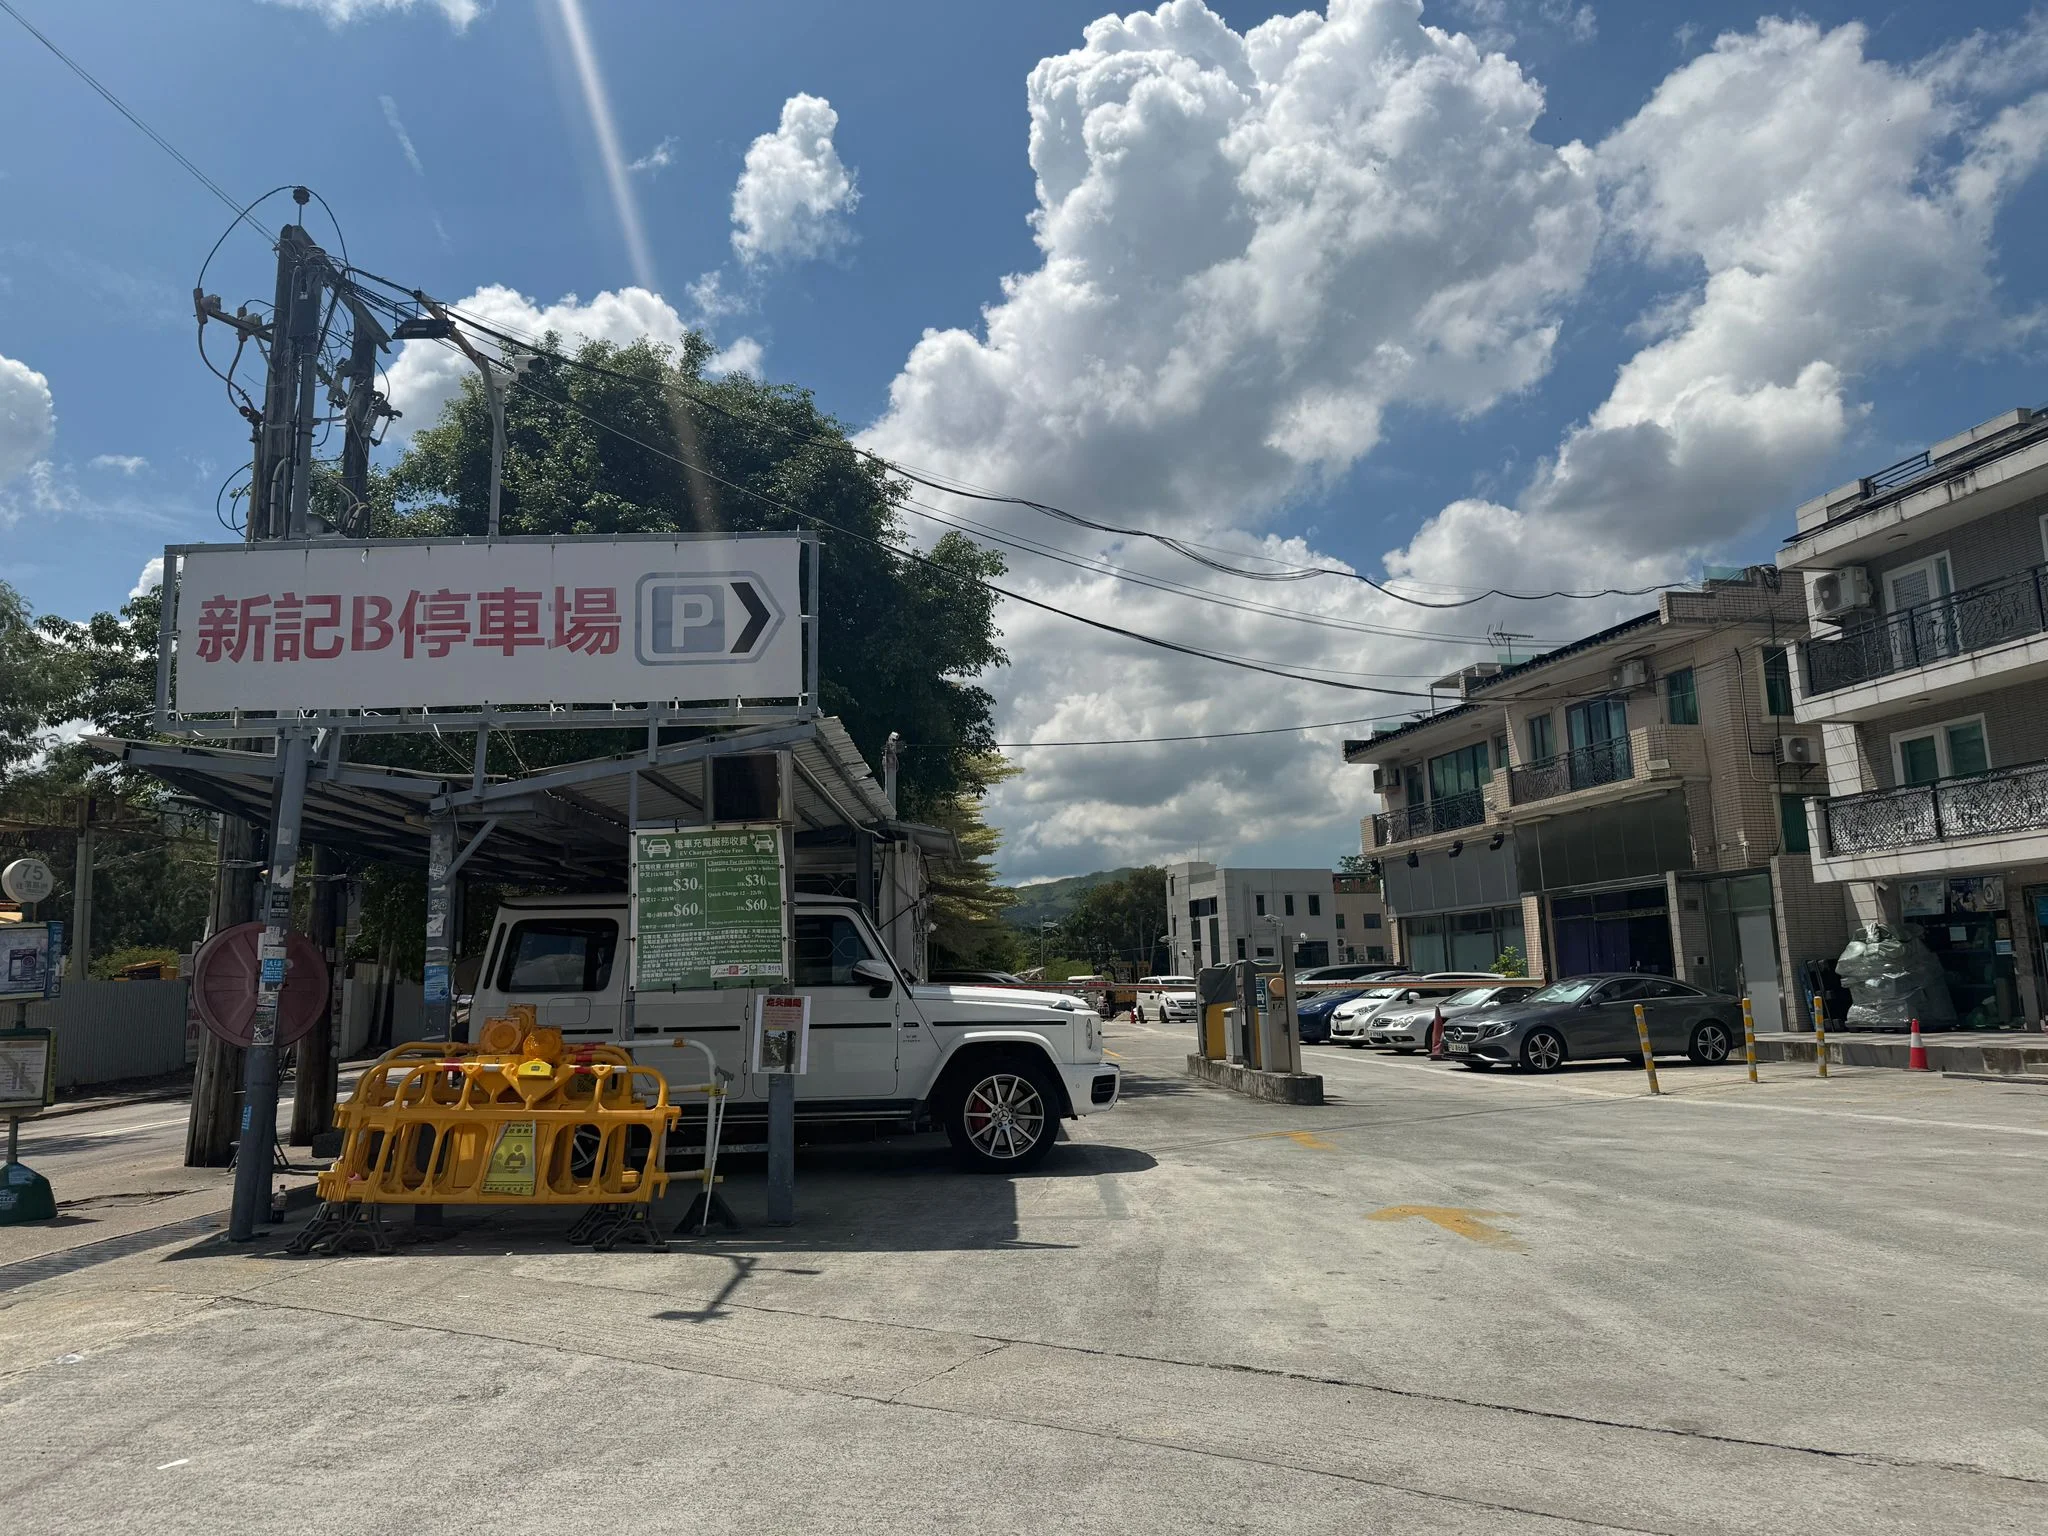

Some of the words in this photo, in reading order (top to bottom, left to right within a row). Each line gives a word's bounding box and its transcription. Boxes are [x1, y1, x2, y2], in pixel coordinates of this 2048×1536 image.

[196, 585, 622, 664] 新記B停車場
[671, 593, 713, 648] P
[21, 863, 44, 881] 75
